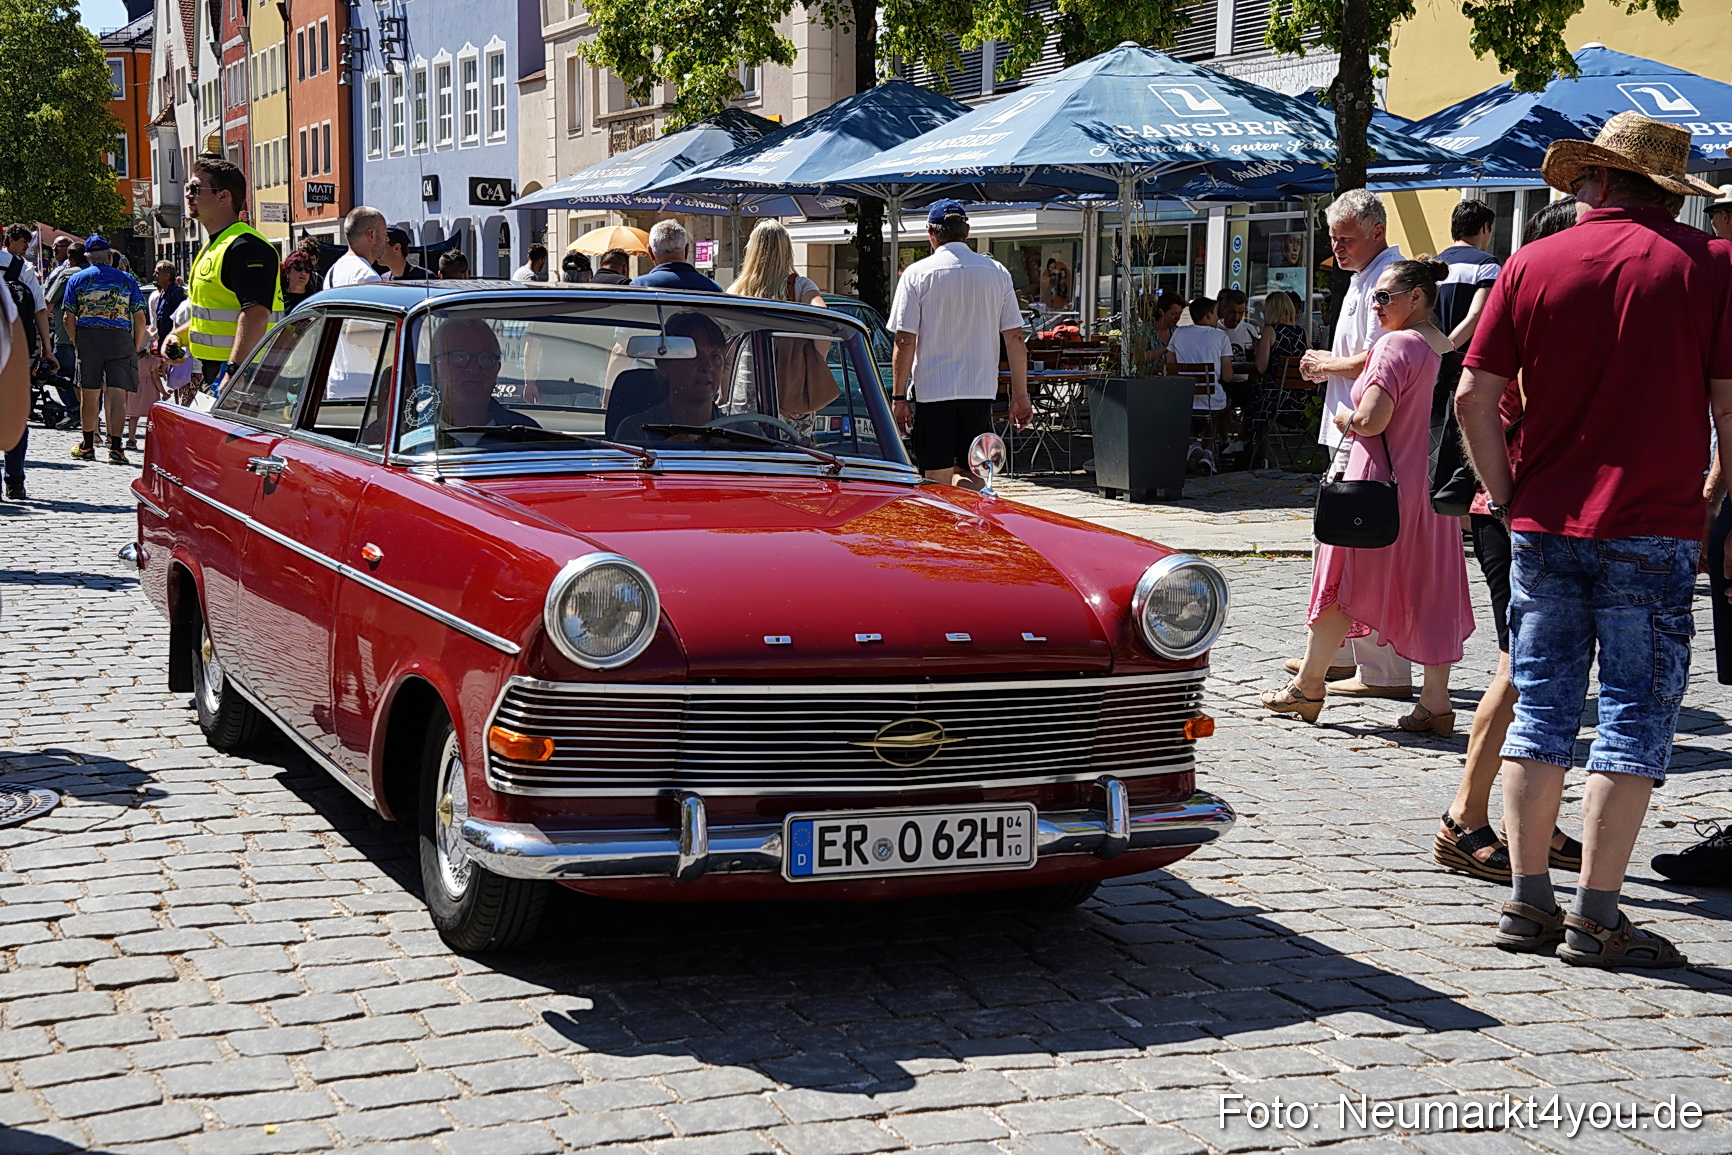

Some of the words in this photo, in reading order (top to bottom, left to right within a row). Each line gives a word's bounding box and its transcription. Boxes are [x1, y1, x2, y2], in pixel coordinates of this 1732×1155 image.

[1112, 120, 1317, 139] GANSBRÄU
[1089, 141, 1220, 157] Neumarkt's
[1228, 140, 1283, 155] guter
[1287, 139, 1339, 153] Schl
[308, 183, 333, 194] MATT
[476, 182, 507, 201] C&A
[311, 194, 330, 202] optik
[764, 632, 1048, 645] OPEL
[797, 853, 807, 866] D
[818, 824, 869, 868] ER
[932, 816, 1004, 861] 62H
[1006, 815, 1022, 829] 04
[1007, 843, 1022, 857] 10
